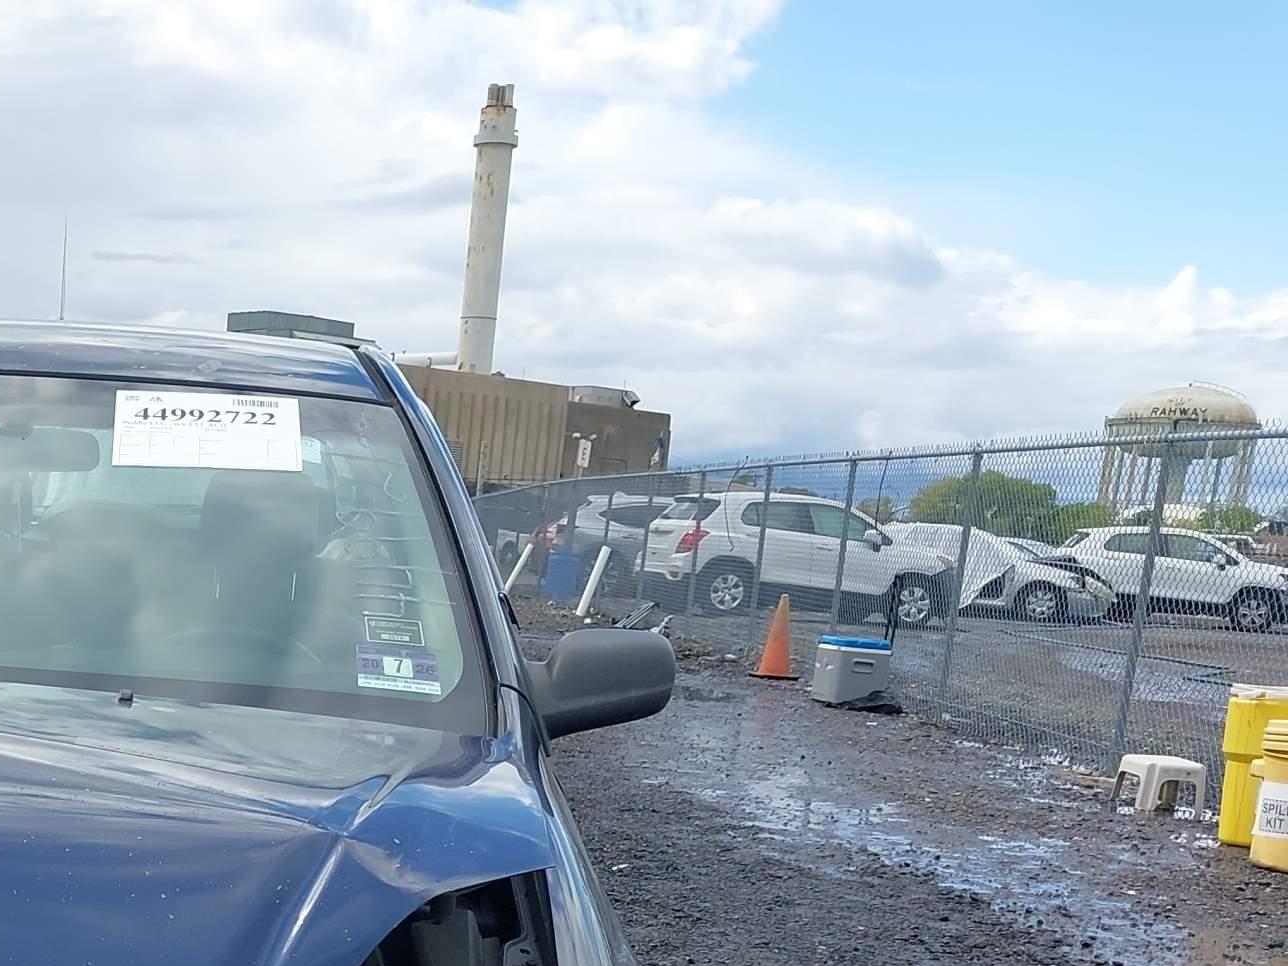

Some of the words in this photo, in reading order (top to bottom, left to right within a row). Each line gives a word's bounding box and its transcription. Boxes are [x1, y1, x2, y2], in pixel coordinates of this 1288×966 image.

[134, 407, 277, 425] 44992722
[1150, 407, 1208, 417] RAHWAY
[362, 658, 379, 668] 20
[393, 658, 404, 673] 7
[415, 664, 434, 675] 26
[1263, 803, 1288, 816] SPIL
[1265, 816, 1285, 829] KIT
